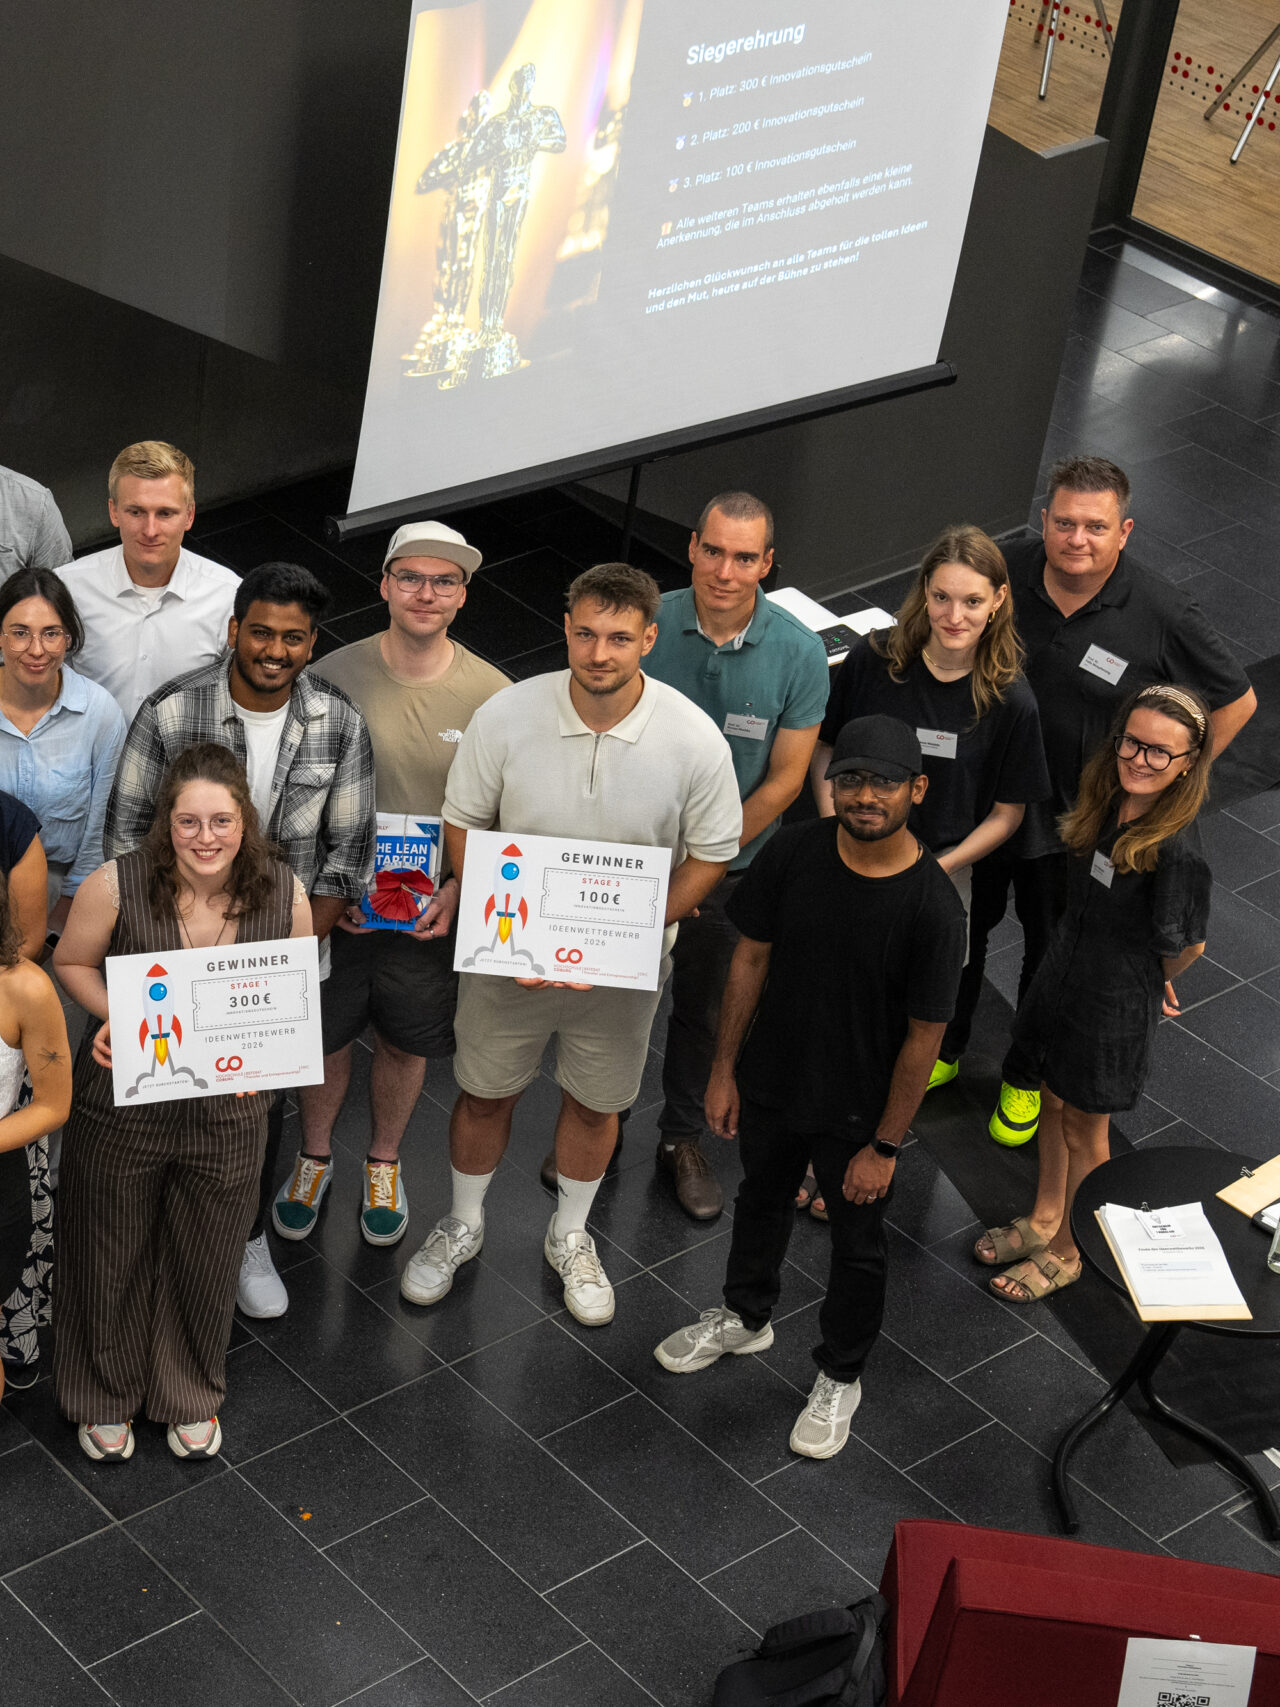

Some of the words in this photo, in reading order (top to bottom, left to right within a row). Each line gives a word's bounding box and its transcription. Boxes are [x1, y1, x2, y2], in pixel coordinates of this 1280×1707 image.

[686, 22, 806, 65] Siegerehrung
[698, 91, 707, 103] 1.
[709, 85, 738, 101] Platz:
[739, 77, 759, 93] 300
[761, 75, 769, 88] €
[769, 51, 873, 86] Innovationsgutschein
[690, 134, 700, 146] 2.
[702, 128, 730, 144] Platz:
[732, 120, 752, 136] 200
[754, 117, 761, 130] €
[762, 96, 865, 129] Innovationsgutschein
[683, 176, 693, 189] 3.
[695, 171, 723, 186] Platz:
[725, 163, 744, 178] 100
[746, 161, 753, 173] €
[754, 138, 857, 171] Innovationsgutschein
[676, 217, 696, 231] Alle
[697, 206, 740, 225] weiteren
[741, 198, 775, 214] Teams
[776, 188, 816, 207] erhalten
[817, 176, 861, 196] ebenfalls
[862, 170, 883, 184] eine
[884, 163, 913, 179] kleine
[656, 224, 723, 250] Anerkennung,
[724, 218, 740, 232] die
[741, 216, 755, 228] im
[756, 204, 807, 224] Anschluss
[807, 192, 850, 212] abgeholt
[851, 182, 887, 201] werden
[888, 176, 913, 191] kann.
[647, 278, 702, 299] Herzlichen
[703, 259, 771, 285] Glückwunsch
[772, 258, 786, 269] an
[786, 254, 806, 267] alle
[806, 243, 838, 260] Teams
[839, 239, 854, 252] für
[854, 235, 871, 247] die
[871, 227, 900, 243] tollen
[900, 220, 929, 236] Ideen
[645, 300, 665, 314] und
[666, 295, 686, 309] den
[687, 290, 710, 304] Mut,
[711, 282, 741, 297] heute
[741, 276, 759, 291] auf
[759, 273, 777, 286] der
[777, 265, 809, 282] Bühne
[809, 262, 823, 275] zu
[823, 251, 860, 270] stehen!
[375, 841, 392, 854] HE
[396, 843, 428, 855] LEAN
[376, 853, 427, 867] TARTUP
[560, 852, 645, 870] GEWINNER
[581, 877, 612, 888] STAGE
[615, 880, 621, 888] 3
[579, 891, 622, 905] 100€
[548, 924, 641, 940] IDEENWETTBEWERB
[583, 938, 607, 947] 2026
[206, 954, 290, 973] GEWINNER
[230, 980, 261, 990] STAGE
[229, 992, 272, 1008] 300€
[204, 1027, 297, 1043] IDEENWETTBEWERB
[241, 1041, 264, 1050] 2026
